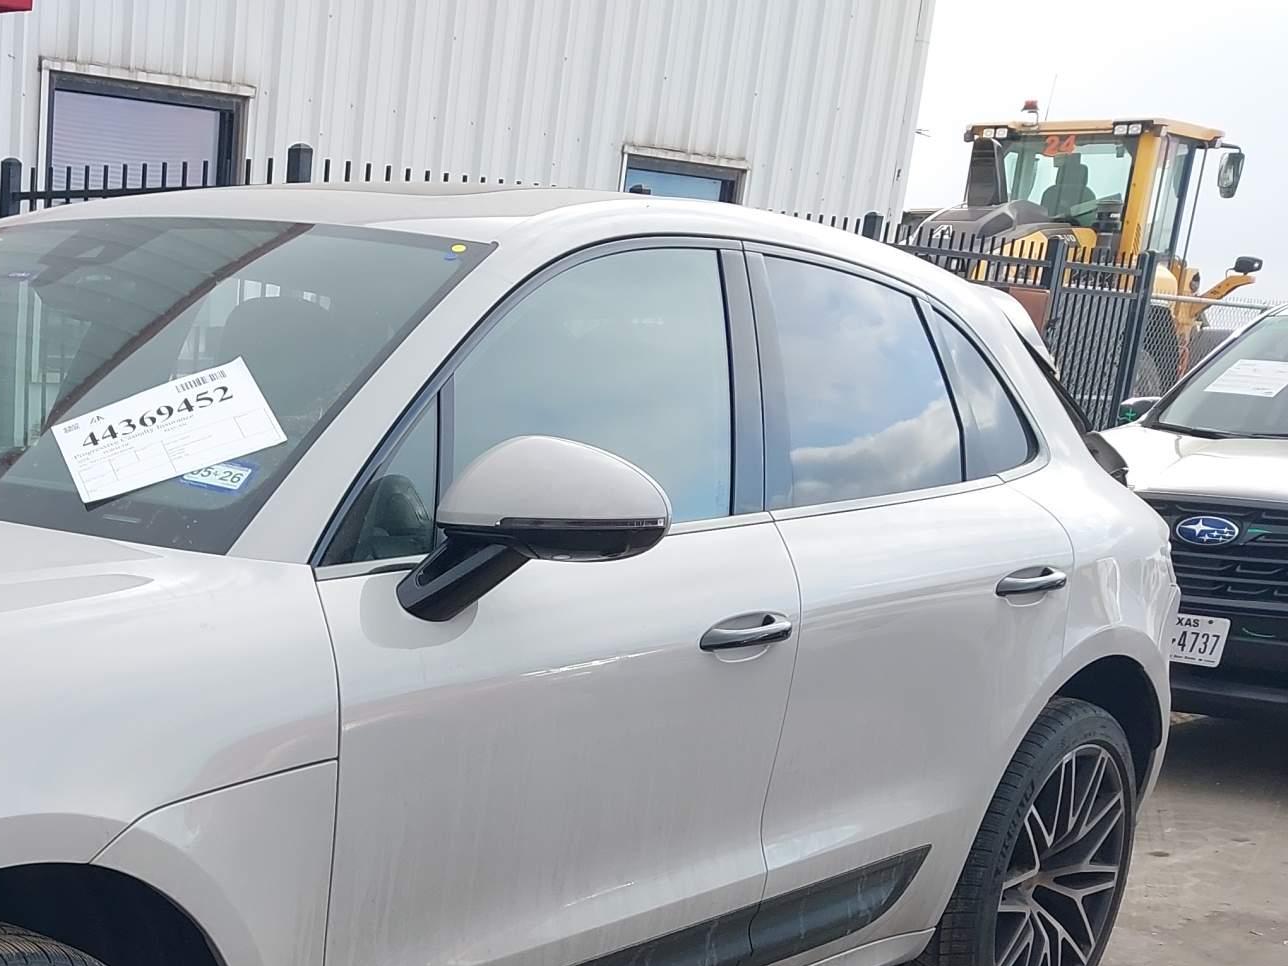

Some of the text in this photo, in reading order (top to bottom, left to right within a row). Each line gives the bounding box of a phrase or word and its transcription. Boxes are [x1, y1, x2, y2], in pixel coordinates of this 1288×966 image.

[1043, 134, 1077, 156] 24
[82, 385, 234, 448] 44369452
[218, 470, 244, 483] 26
[1176, 616, 1200, 628] XAS
